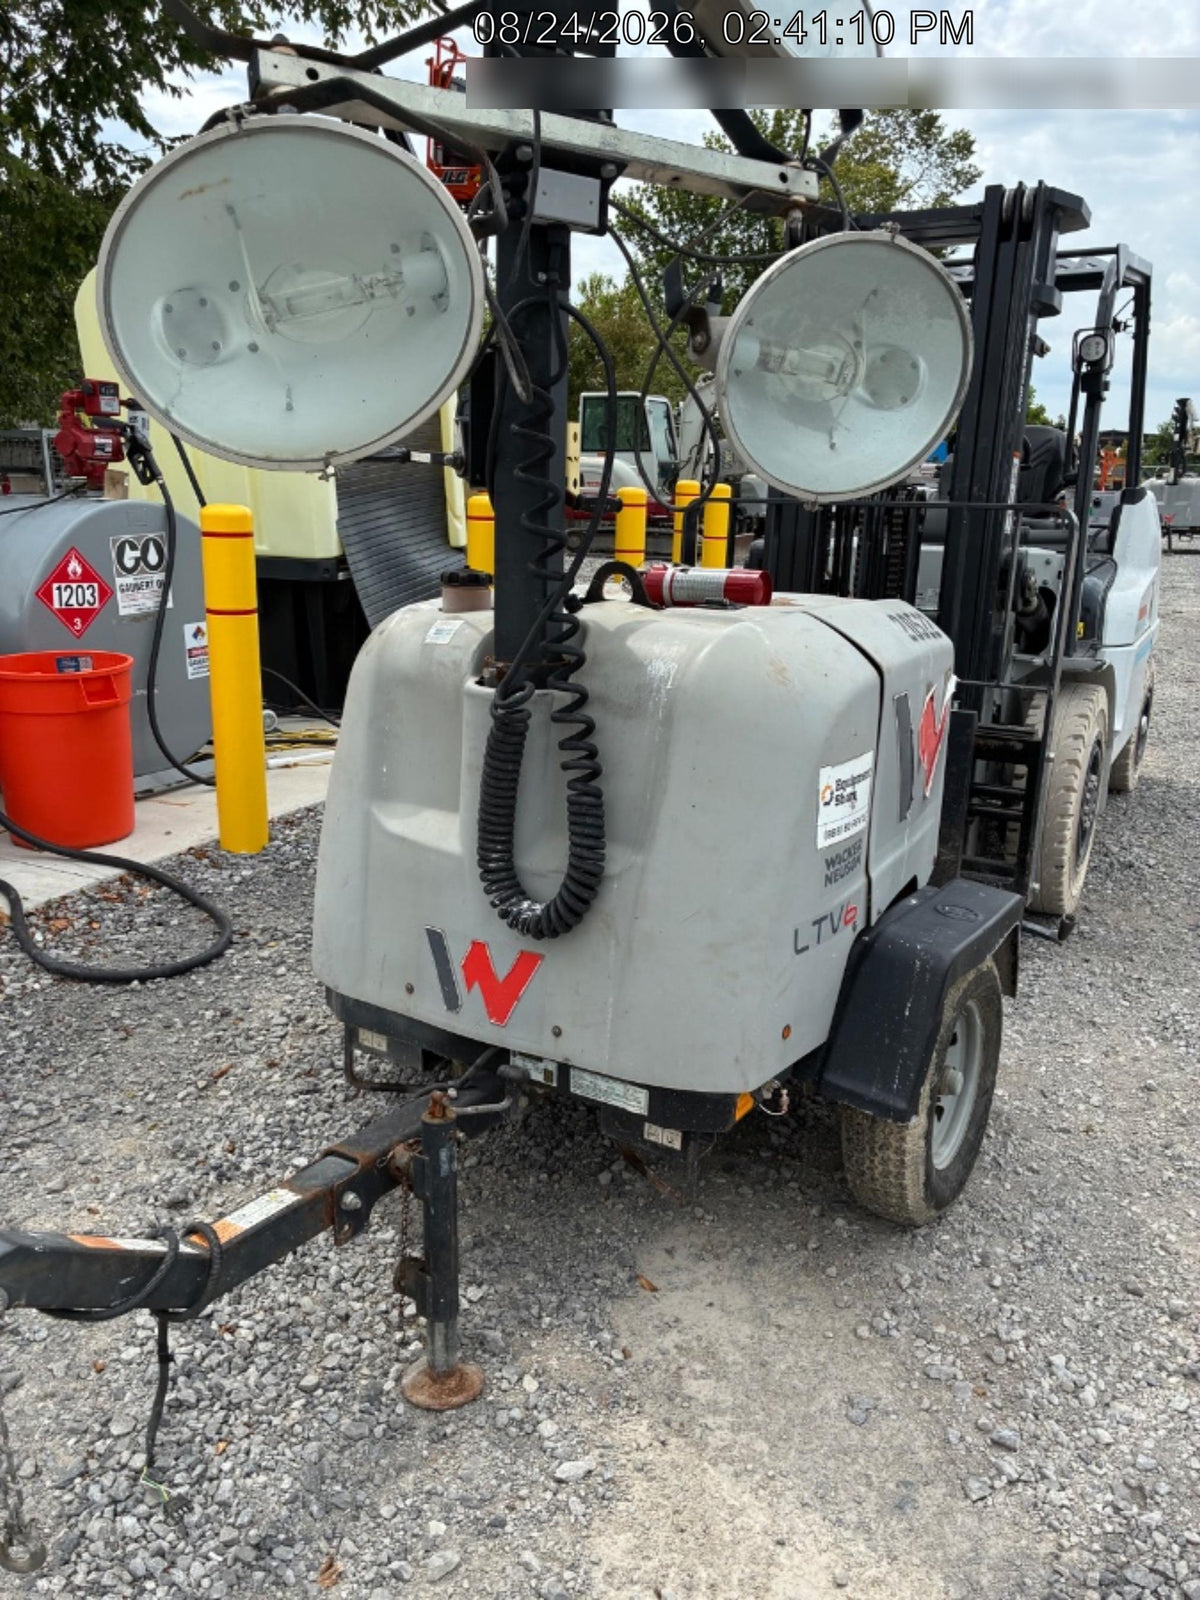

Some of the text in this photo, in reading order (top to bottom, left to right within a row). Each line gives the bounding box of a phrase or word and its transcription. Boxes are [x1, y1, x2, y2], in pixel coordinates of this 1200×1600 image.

[116, 537, 164, 574] GO
[55, 584, 97, 607] 1203
[73, 617, 82, 630] 3
[824, 838, 862, 870] WACKER
[825, 855, 861, 887] NEUSON
